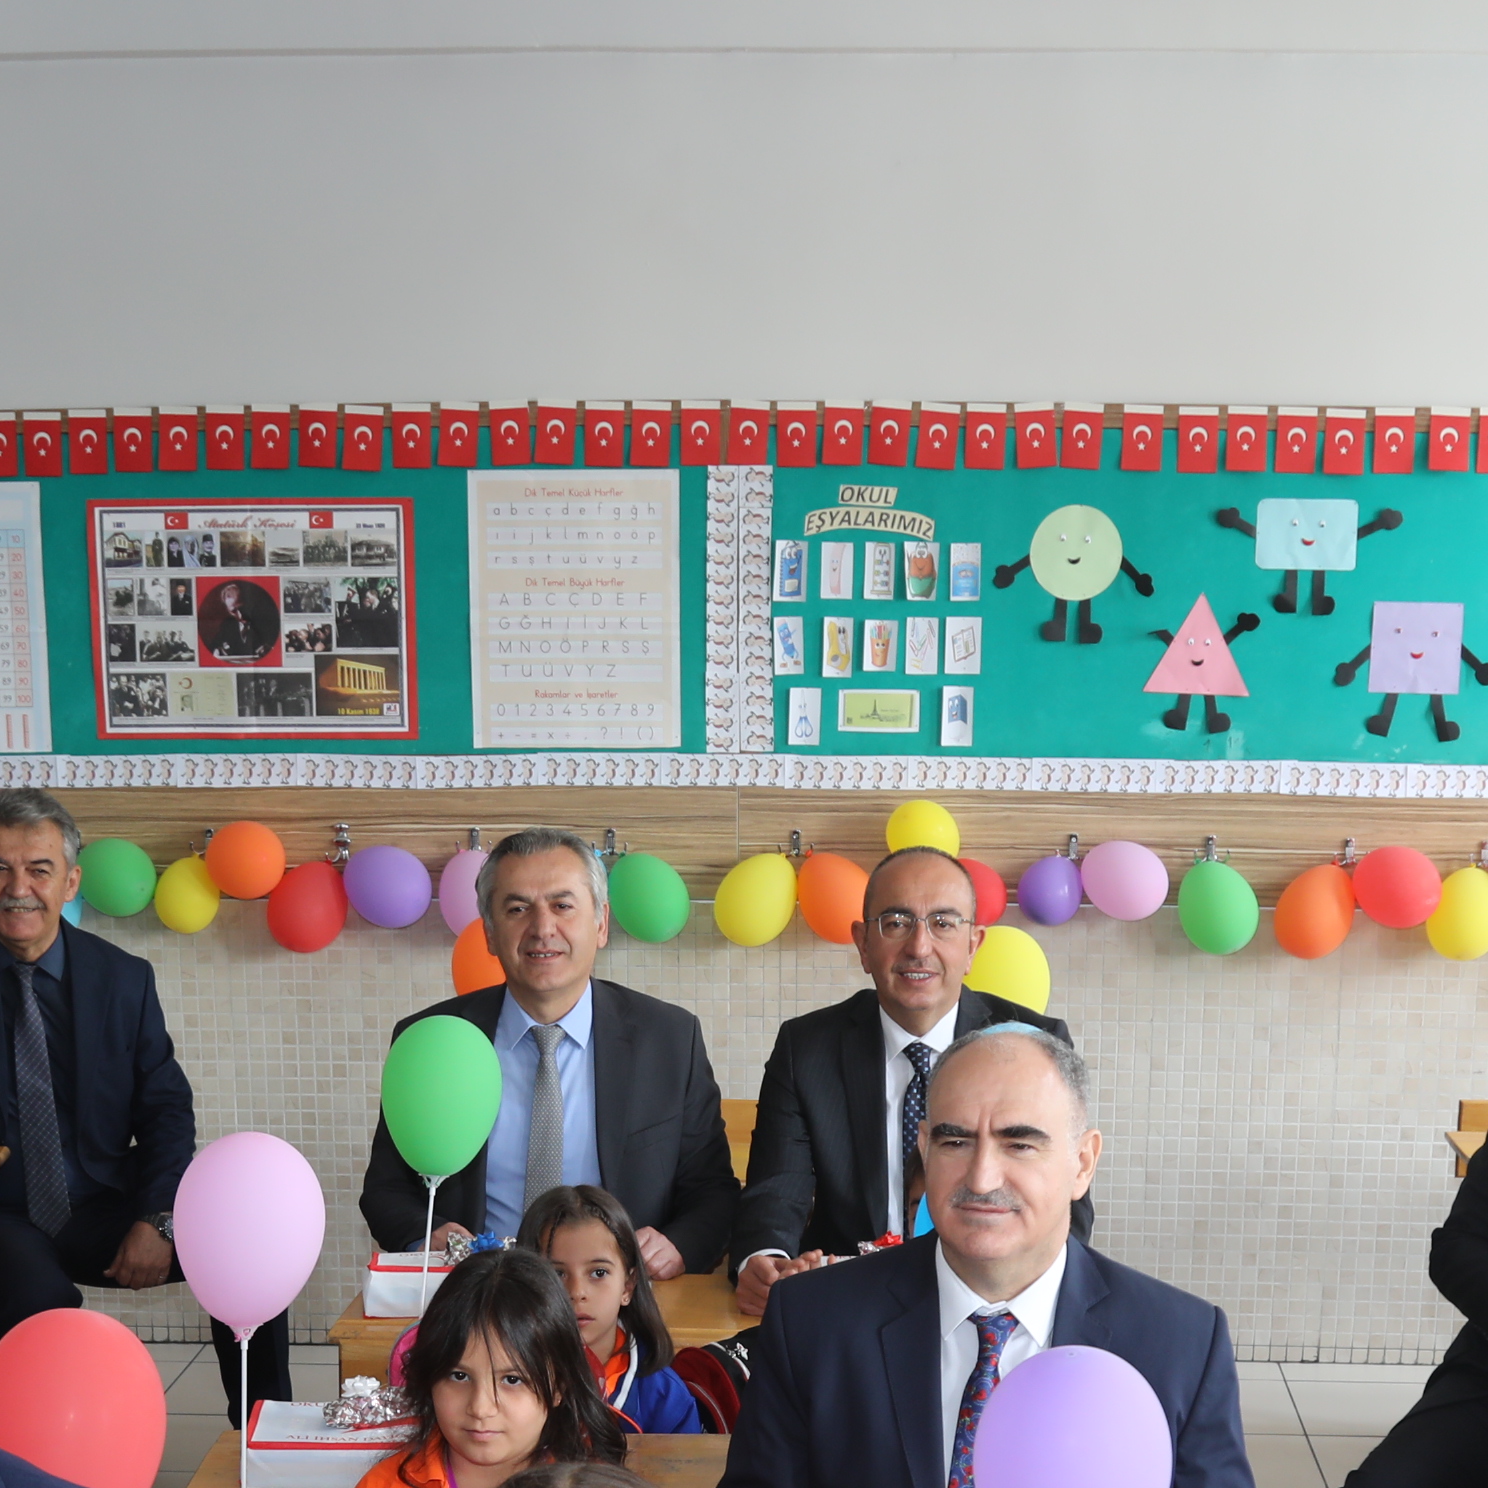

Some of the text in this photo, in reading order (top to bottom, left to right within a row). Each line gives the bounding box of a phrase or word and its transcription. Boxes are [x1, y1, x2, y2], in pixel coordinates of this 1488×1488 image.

[524, 488, 624, 498] Dik Temel Küçük Harfler
[840, 486, 893, 505] OKUL
[197, 514, 253, 529] Atatürk
[805, 510, 934, 539] EŞYALARIMIZ
[10, 534, 21, 544] 10
[525, 577, 625, 589] Dik Temel Büyük Harfler
[499, 592, 647, 608] A B C Ç D E F
[498, 616, 510, 630] G
[519, 614, 532, 630] Ğ
[541, 617, 552, 629] H
[598, 617, 606, 629] J
[619, 617, 627, 629] K
[641, 617, 648, 630] L
[499, 638, 649, 656] M N O Ö P R S Ş
[501, 662, 616, 677] T U Ü V Y Z
[534, 689, 571, 698] Rakamlar
[497, 703, 506, 716] 0
[529, 703, 537, 717] 2
[546, 703, 554, 716] 3
[563, 704, 572, 716] 4
[580, 703, 588, 717] 5
[597, 704, 605, 716] 6
[614, 703, 621, 716] 7
[630, 703, 638, 716] 8
[647, 703, 654, 716] 9
